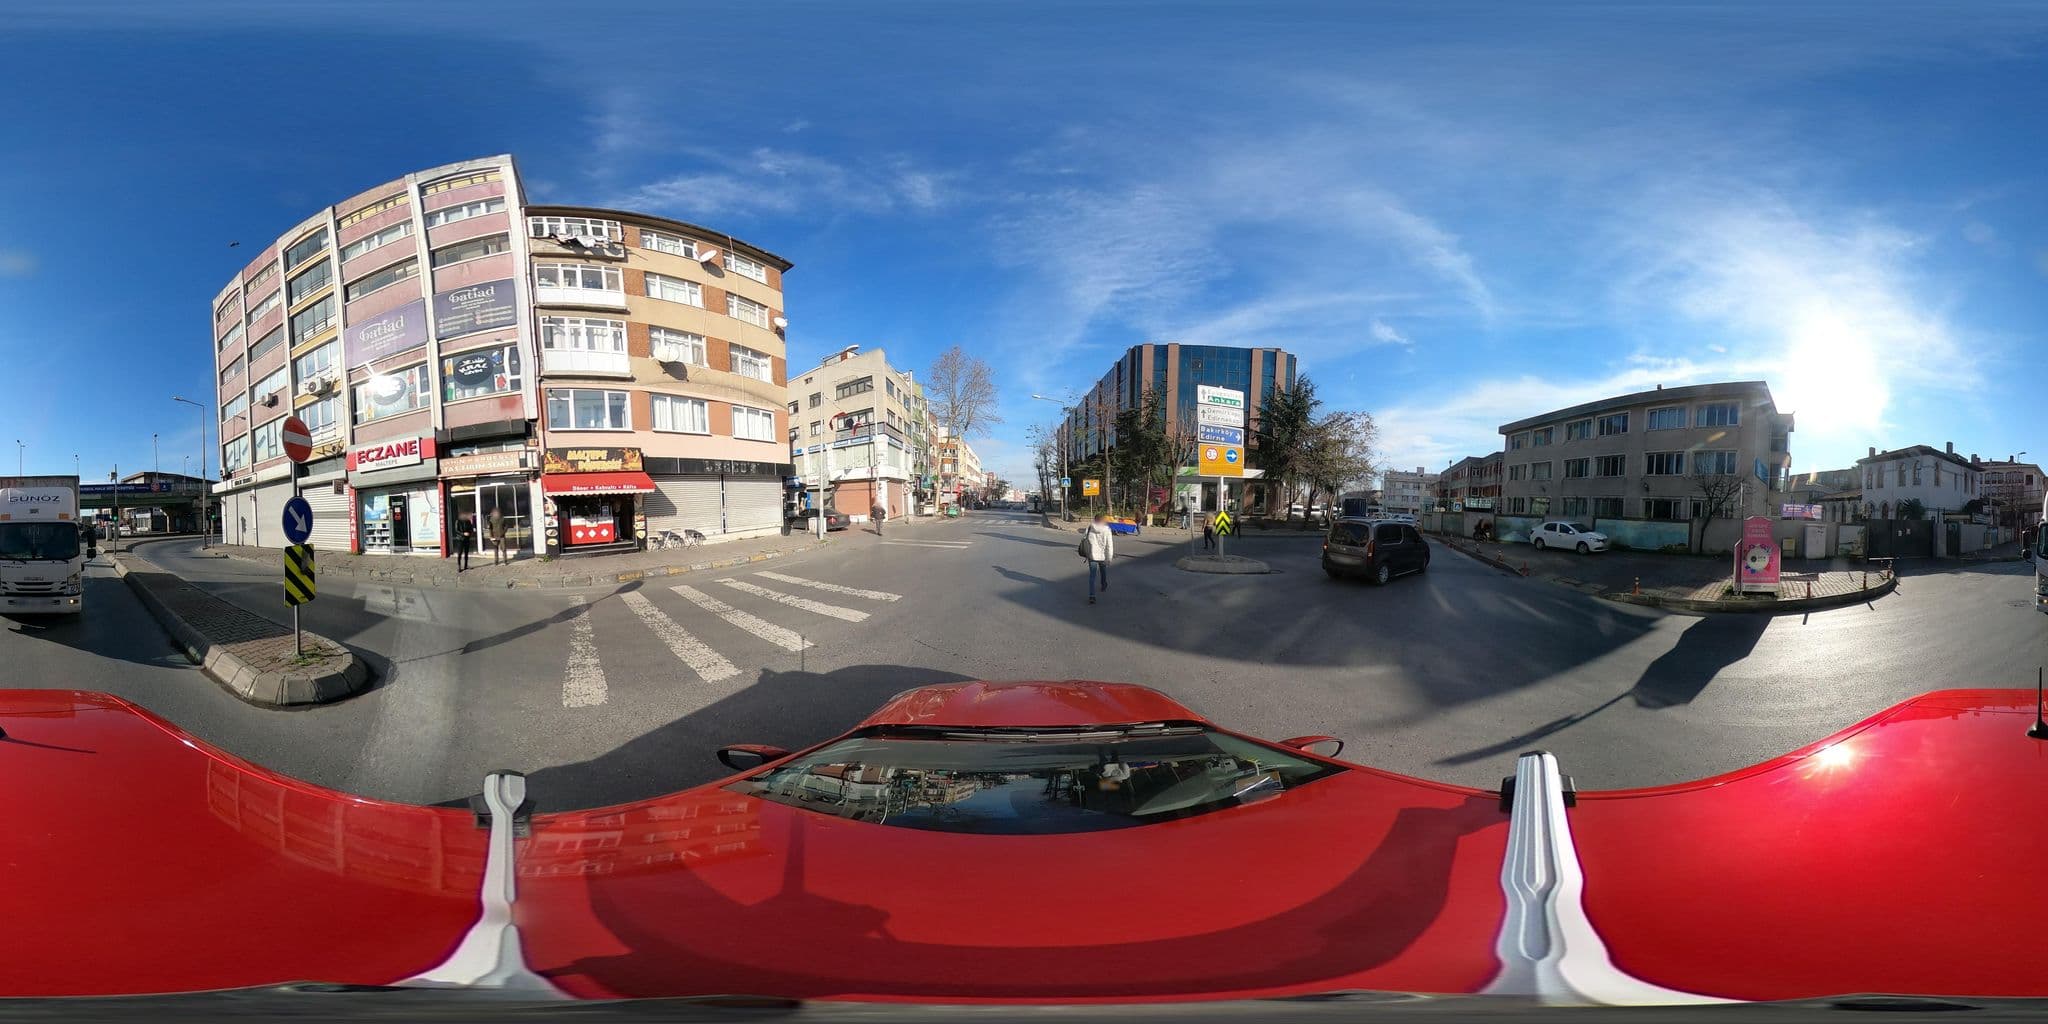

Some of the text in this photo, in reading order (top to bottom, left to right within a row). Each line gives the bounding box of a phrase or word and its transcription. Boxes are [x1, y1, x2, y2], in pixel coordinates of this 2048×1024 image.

[1208, 396, 1241, 406] Ankara
[1200, 425, 1234, 437] Bakırköy
[1200, 433, 1225, 441] Edirne
[357, 440, 418, 464] ECZANE
[567, 449, 608, 460] MALTEPE
[9, 492, 61, 503] GÜNÖZ
